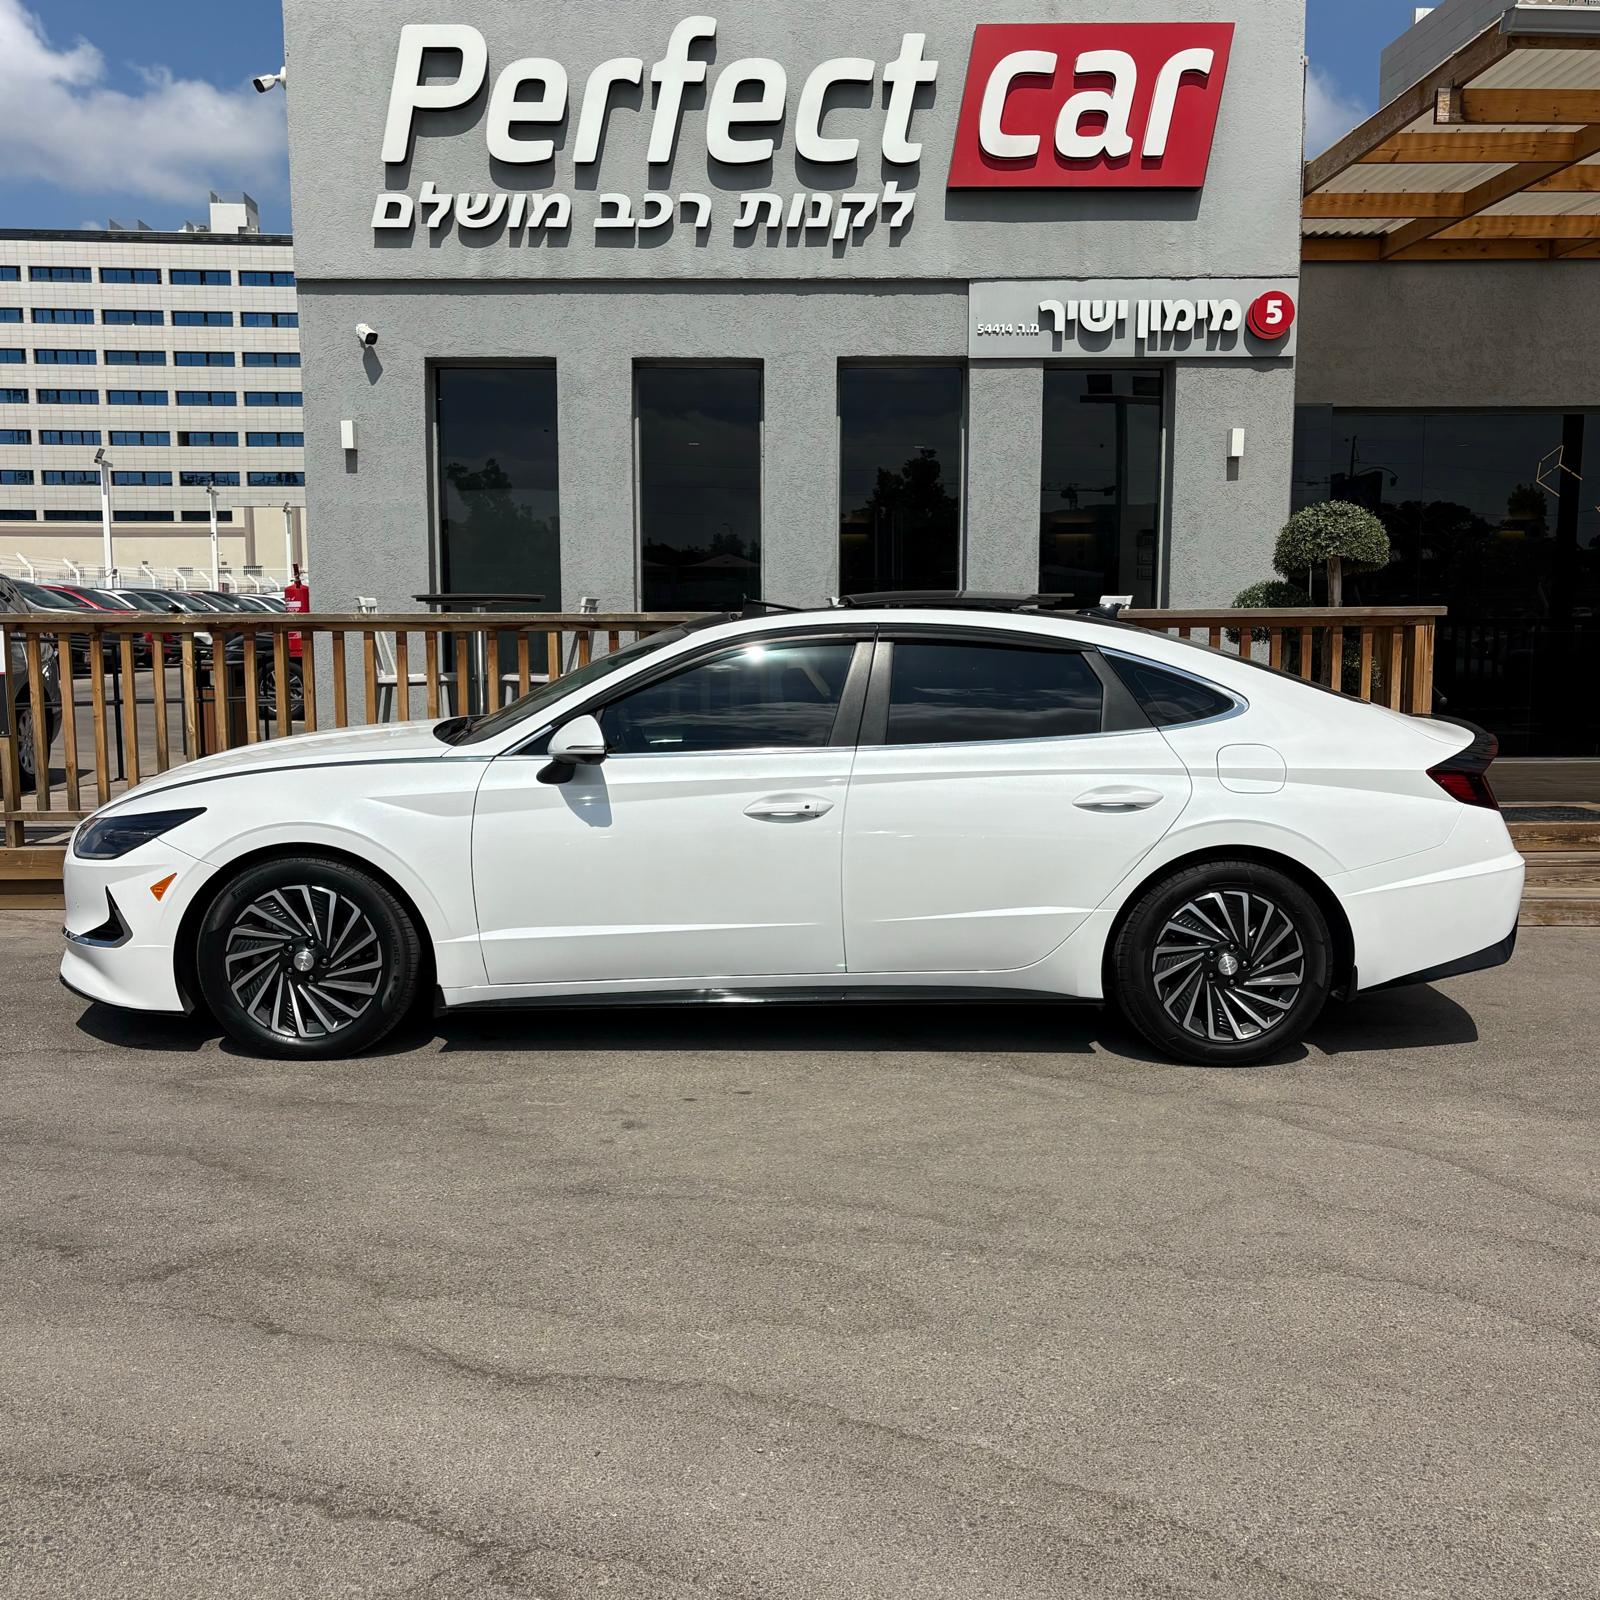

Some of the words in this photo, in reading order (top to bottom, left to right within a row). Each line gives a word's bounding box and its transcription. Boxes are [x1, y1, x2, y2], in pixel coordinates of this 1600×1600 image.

[381, 16, 938, 163] Perfect
[979, 48, 1214, 157] car
[370, 181, 571, 228] מושלם
[593, 192, 712, 228] רכב
[732, 181, 916, 239] לקנות
[977, 323, 1014, 334] 54414
[1039, 298, 1129, 333] ישיר
[1137, 298, 1242, 338] מימון
[1265, 299, 1283, 325] 5
